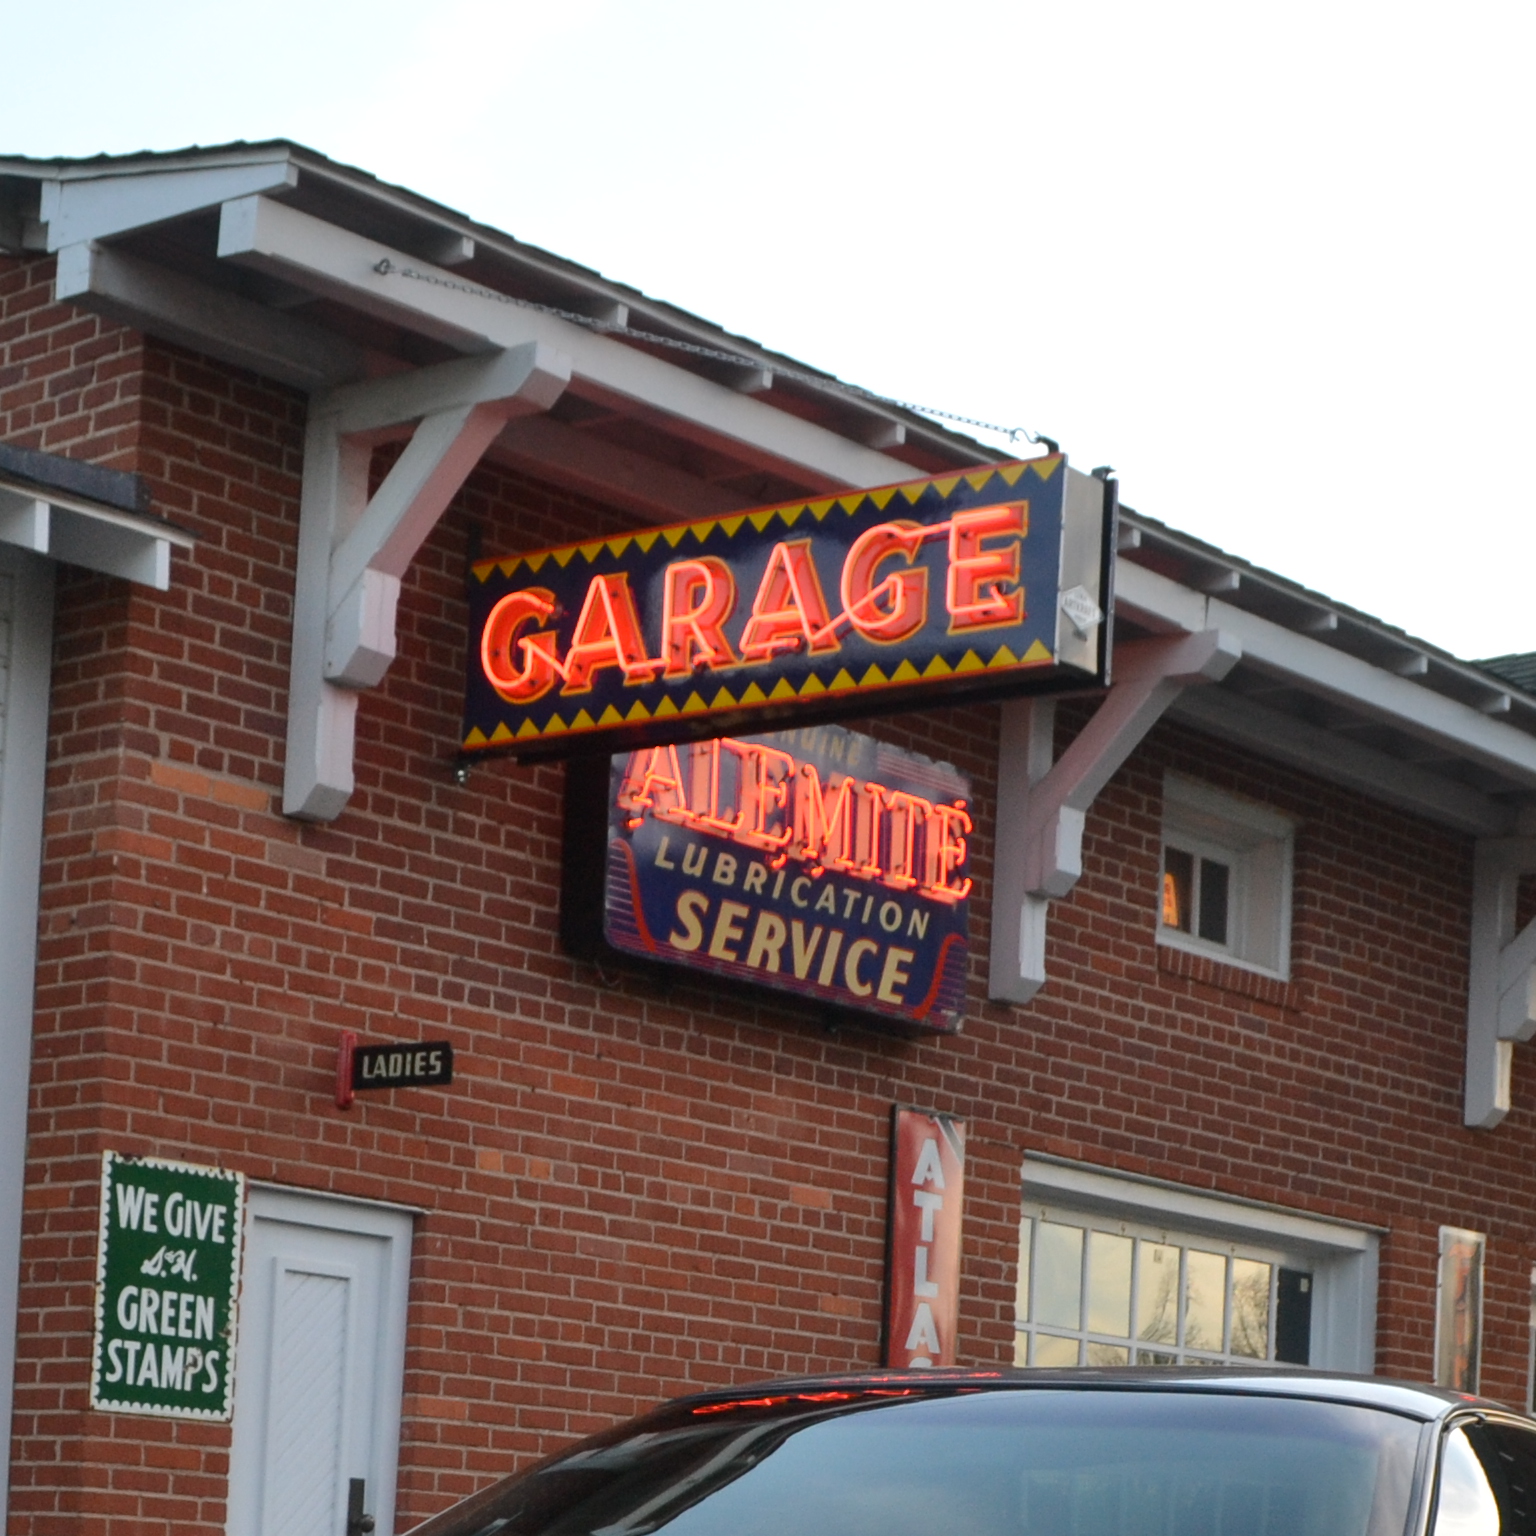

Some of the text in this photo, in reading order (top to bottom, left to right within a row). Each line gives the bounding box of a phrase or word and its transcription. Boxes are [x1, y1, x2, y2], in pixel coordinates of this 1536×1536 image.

[481, 500, 1030, 704] GARAGE
[616, 736, 973, 904] ALEMITE
[654, 834, 930, 939] LUBRICATION
[670, 889, 916, 1005] SERVICE
[361, 1050, 443, 1079] LADIES
[116, 1182, 228, 1245] WE GIVE
[904, 1137, 946, 1368] ATLA
[116, 1284, 215, 1342] GREEN
[104, 1338, 220, 1394] STAMPS
